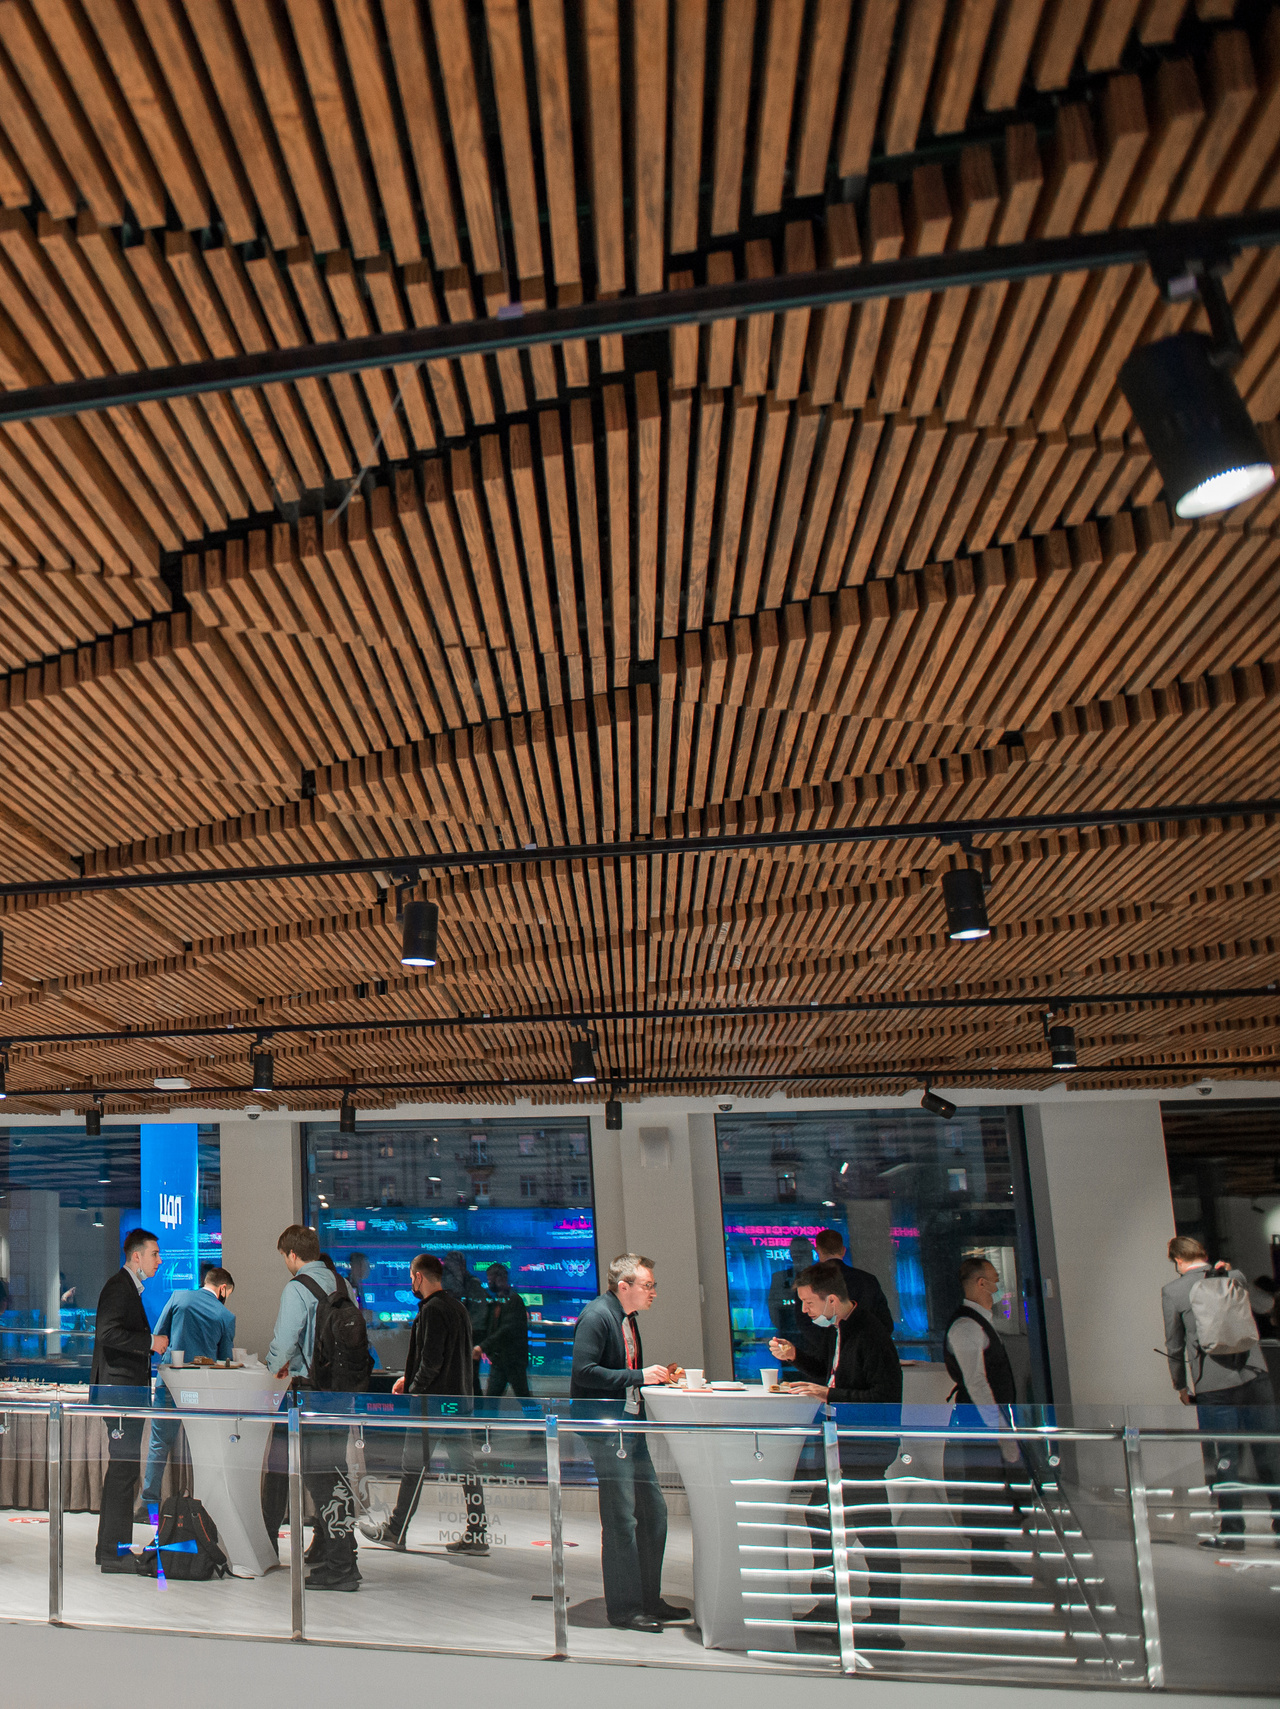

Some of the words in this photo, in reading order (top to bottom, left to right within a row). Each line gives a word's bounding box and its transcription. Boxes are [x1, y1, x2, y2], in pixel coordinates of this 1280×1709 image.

[437, 1473, 528, 1487] АГЕНТСТВО
[438, 1492, 538, 1508] ИННОВАЦИЙ
[438, 1511, 502, 1528] ГОРОДА
[438, 1530, 507, 1545] МОСКВЫ
